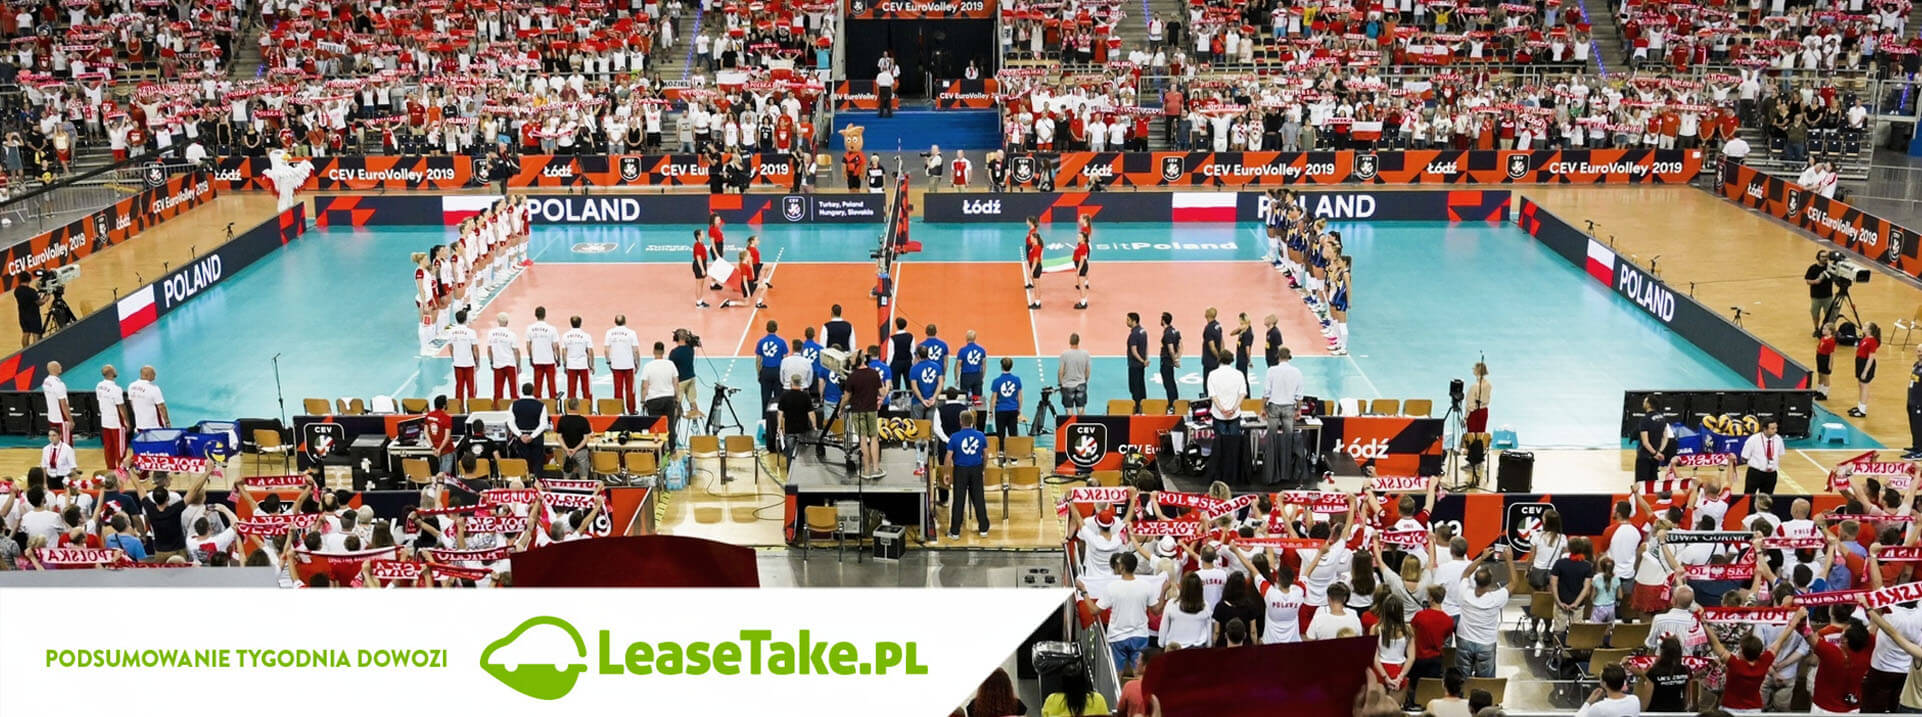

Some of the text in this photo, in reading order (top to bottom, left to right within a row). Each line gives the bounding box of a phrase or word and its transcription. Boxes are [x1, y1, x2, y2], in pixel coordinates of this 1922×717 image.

[882, 1, 983, 13] CEV EuroVolley 2019
[940, 92, 987, 101] CEV EuroVolley
[215, 168, 242, 181] Łódź
[543, 164, 573, 177] Łódź
[660, 164, 687, 177] CEV
[760, 163, 789, 176] 2019
[1083, 163, 1113, 177] Łódź
[1203, 163, 1335, 179] CEV EuroVolley 2019
[1426, 161, 1457, 174] Łódź
[1550, 161, 1682, 177] CEV EuroVolley 2019
[329, 168, 455, 184] CEV EuroVolley 2019
[152, 180, 209, 214] CEV EuroVolley 2019
[528, 199, 641, 222] POLAND
[962, 199, 1001, 214] Łódź
[1257, 195, 1376, 219] PAND
[1807, 205, 1878, 247] CEV EuroVolley 2019
[8, 232, 86, 276] CEV EuroVolley 2019
[163, 254, 222, 308] POLAND
[1619, 264, 1675, 322] POLAND
[1077, 426, 1096, 434] CEV
[543, 492, 597, 508] OLSKA
[1158, 493, 1187, 505] POL
[1521, 506, 1543, 514] CEV
